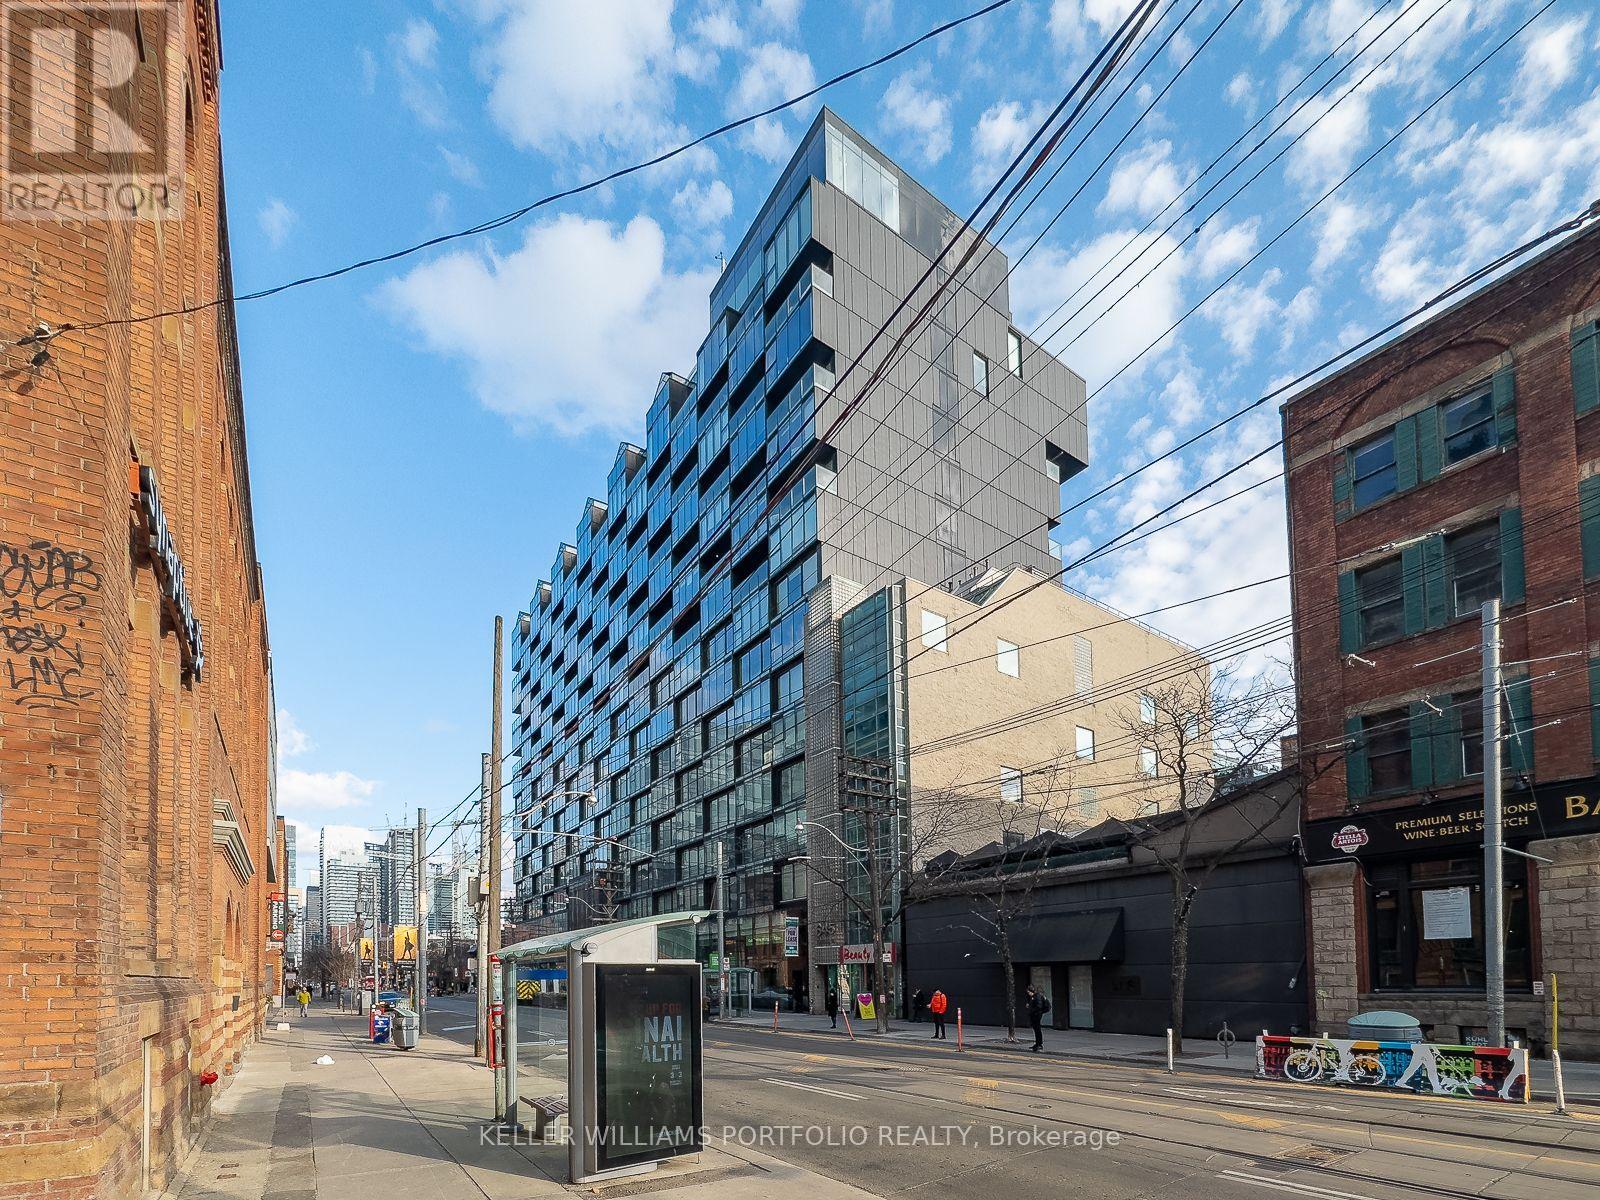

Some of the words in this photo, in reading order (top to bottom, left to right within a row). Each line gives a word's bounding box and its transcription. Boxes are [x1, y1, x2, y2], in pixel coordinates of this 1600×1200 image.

[1395, 815, 1453, 830] PREMIUM
[1458, 802, 1538, 821] SELEIONS
[1337, 838, 1363, 846] ARTOIS
[1338, 833, 1362, 842] STELLA
[843, 947, 871, 962] Beauty
